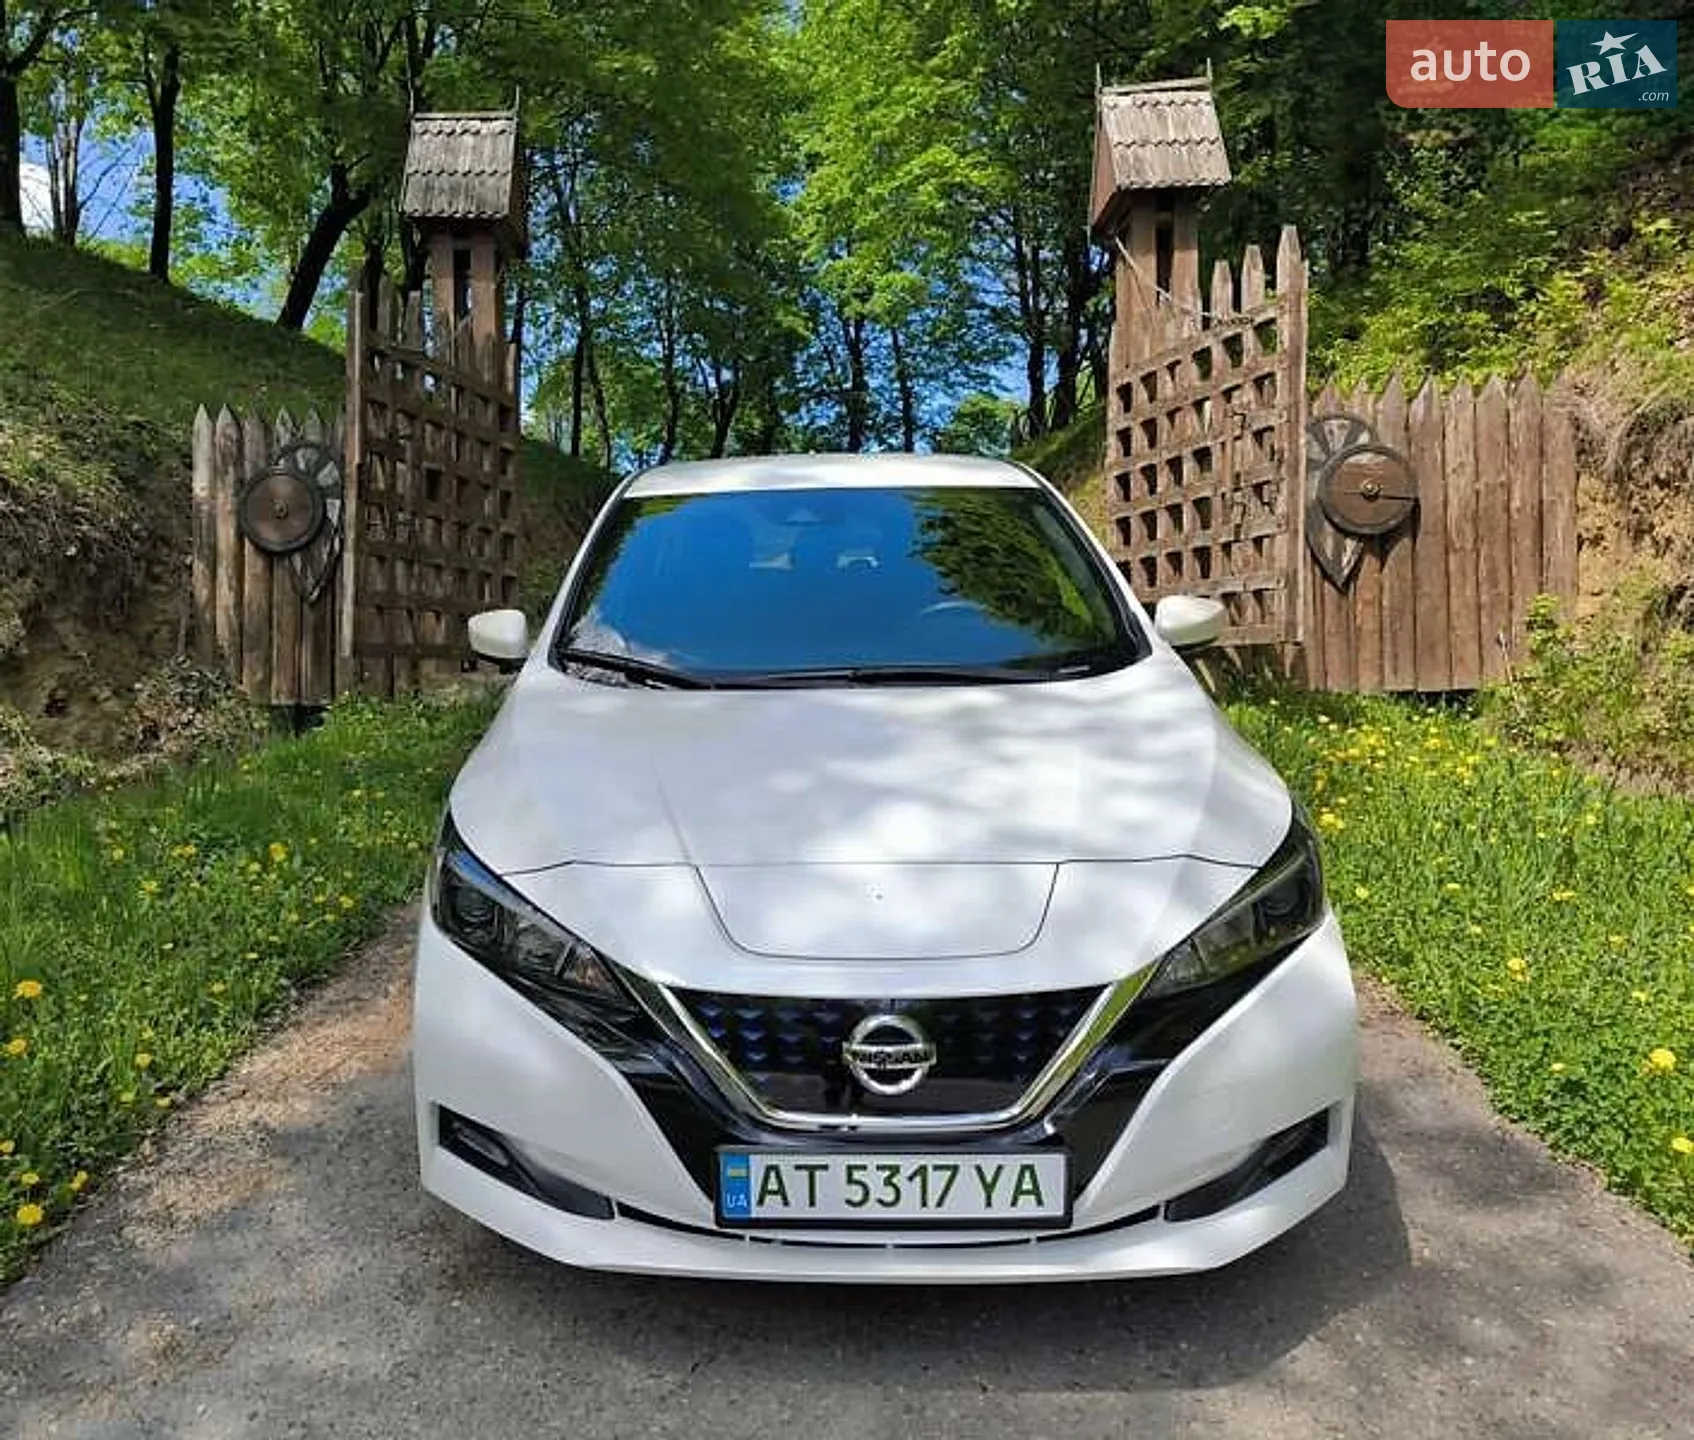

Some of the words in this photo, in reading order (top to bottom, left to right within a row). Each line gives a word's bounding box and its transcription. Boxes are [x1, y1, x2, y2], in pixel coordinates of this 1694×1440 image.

[726, 1192, 748, 1208] UA
[756, 1164, 829, 1208] AT
[844, 1164, 960, 1208] 5317
[975, 1164, 1045, 1208] YA
